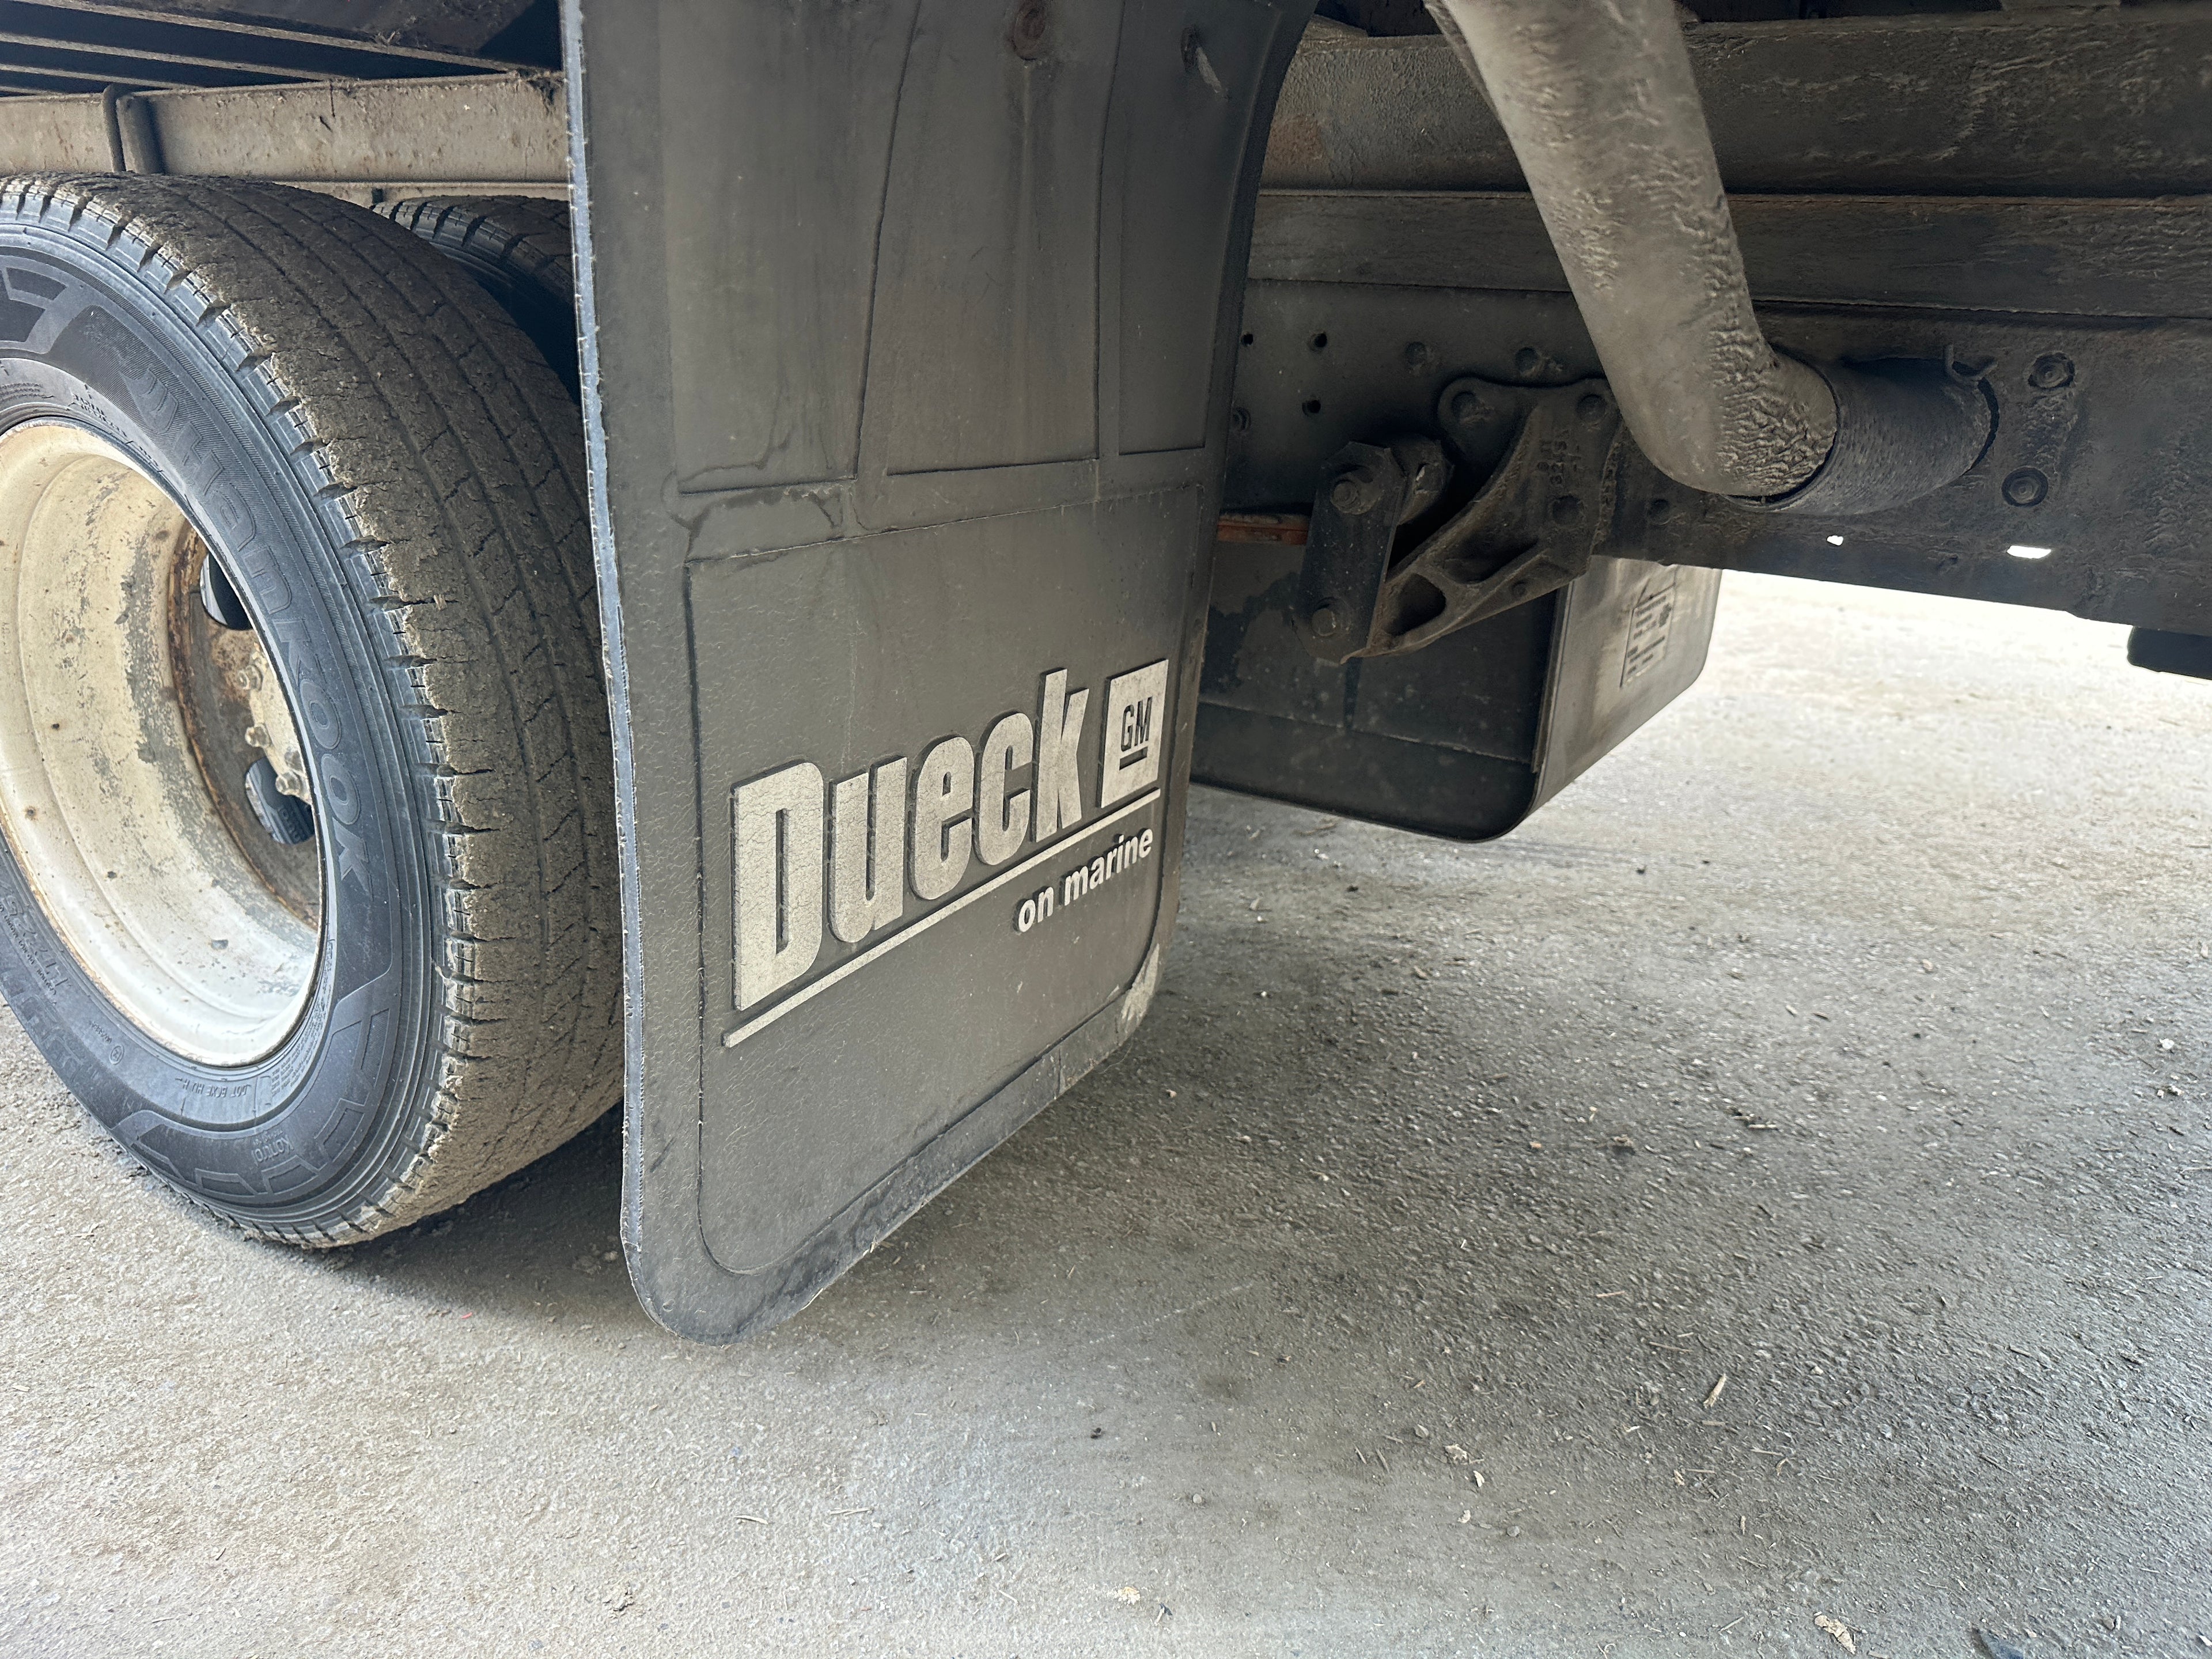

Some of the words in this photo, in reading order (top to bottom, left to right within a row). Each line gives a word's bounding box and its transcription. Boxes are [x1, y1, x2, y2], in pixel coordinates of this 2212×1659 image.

[1120, 696, 1153, 753] GM
[730, 668, 1090, 1012] Dueck
[1016, 884, 1054, 934] on
[1063, 828, 1154, 906] marine
[231, 1084, 249, 1097] DOT
[251, 1134, 294, 1166] Kontrol
